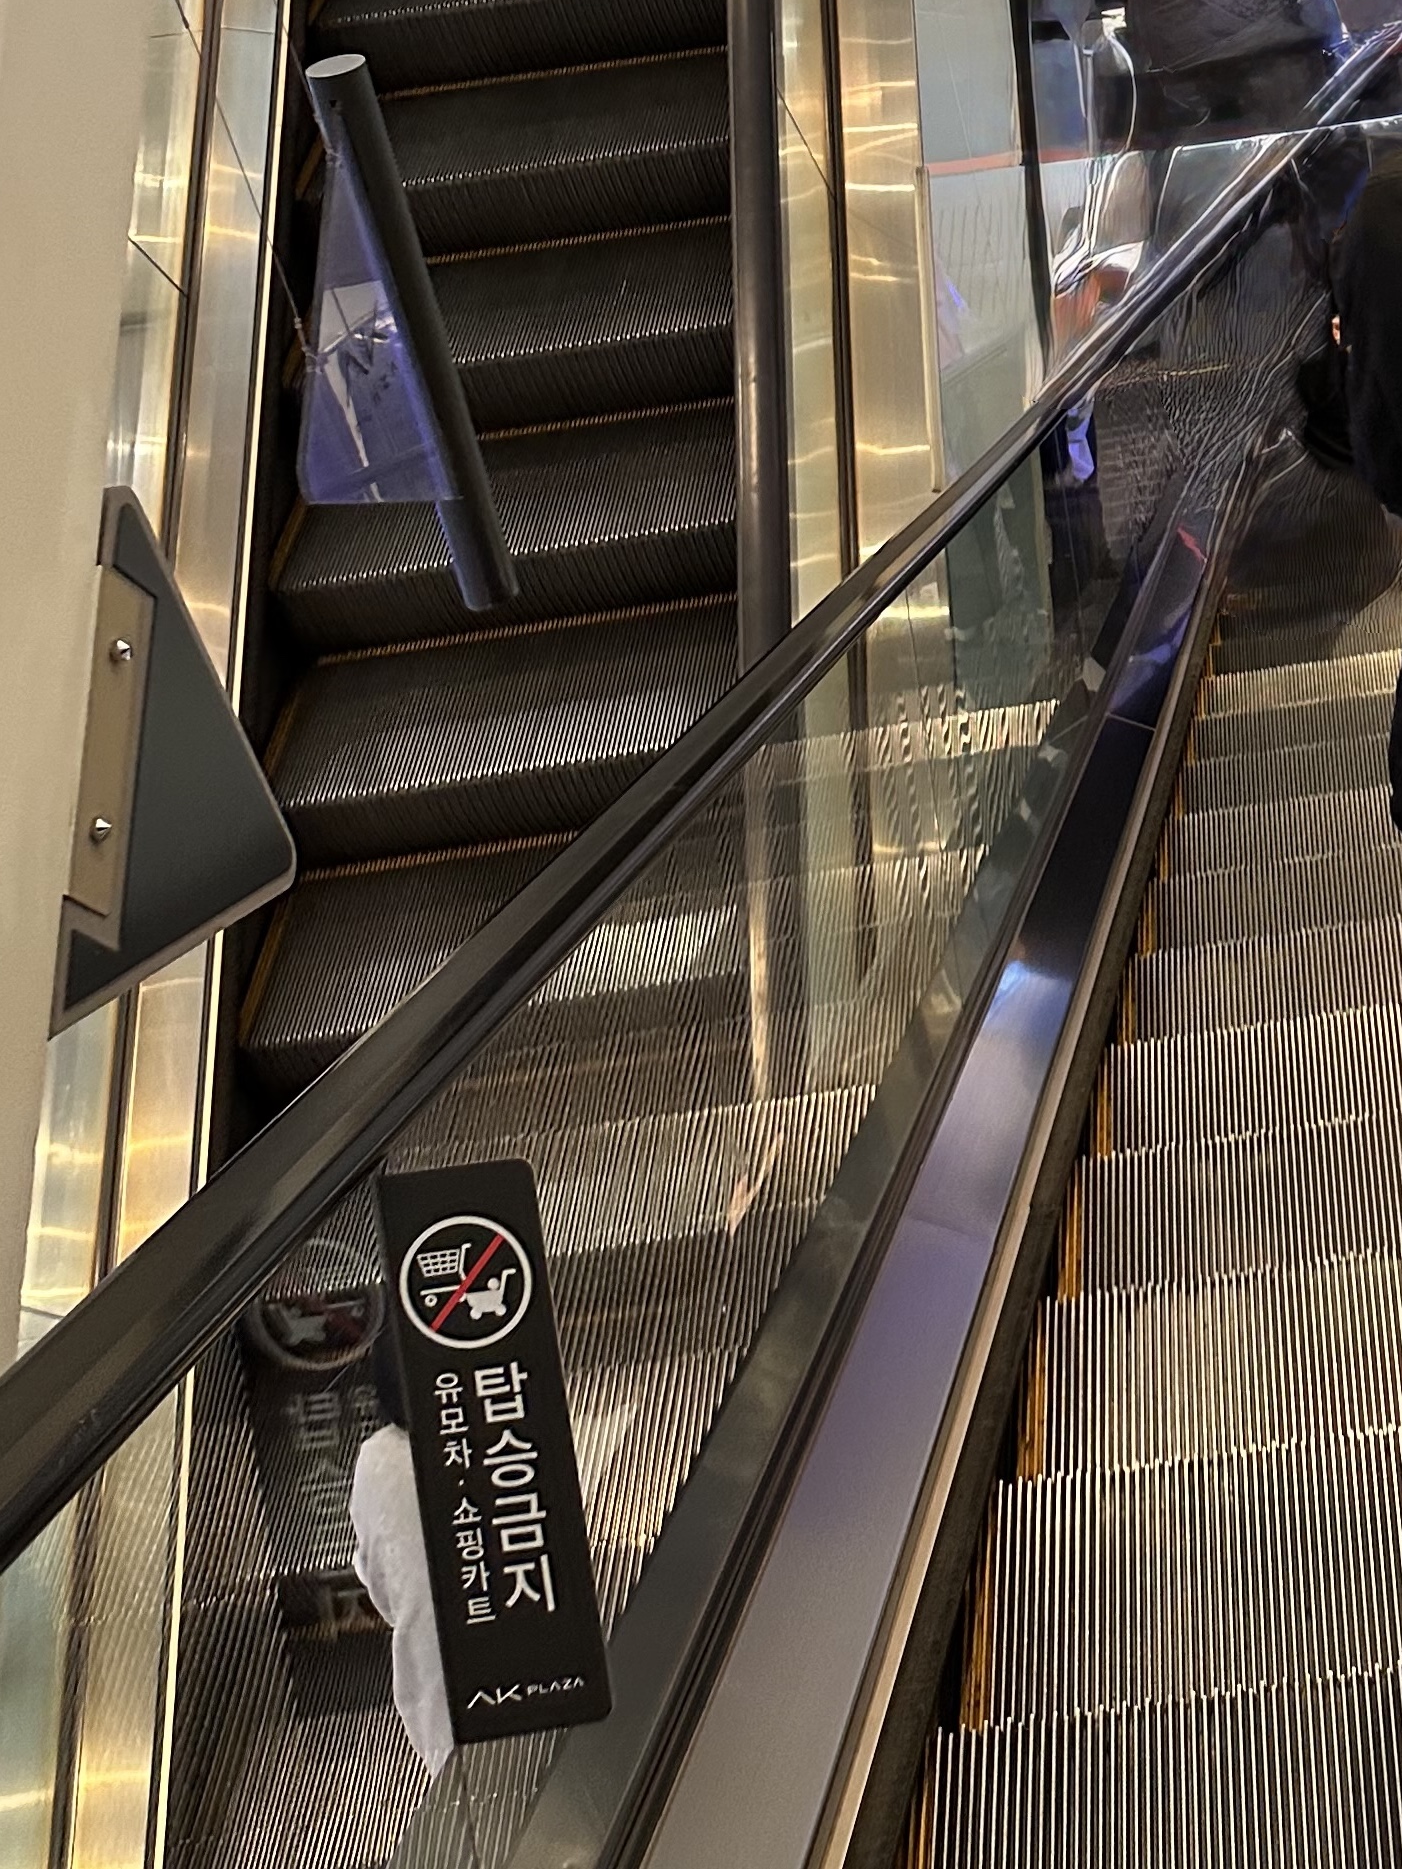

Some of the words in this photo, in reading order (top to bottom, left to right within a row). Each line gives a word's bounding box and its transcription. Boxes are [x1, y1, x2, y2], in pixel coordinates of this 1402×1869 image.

[434, 1372, 473, 1469] 유모차
[474, 1360, 556, 1613] 탑승금지
[452, 1496, 497, 1625] 쇼핑카트
[467, 1683, 522, 1709] AK
[527, 1676, 585, 1697] PLAZA
